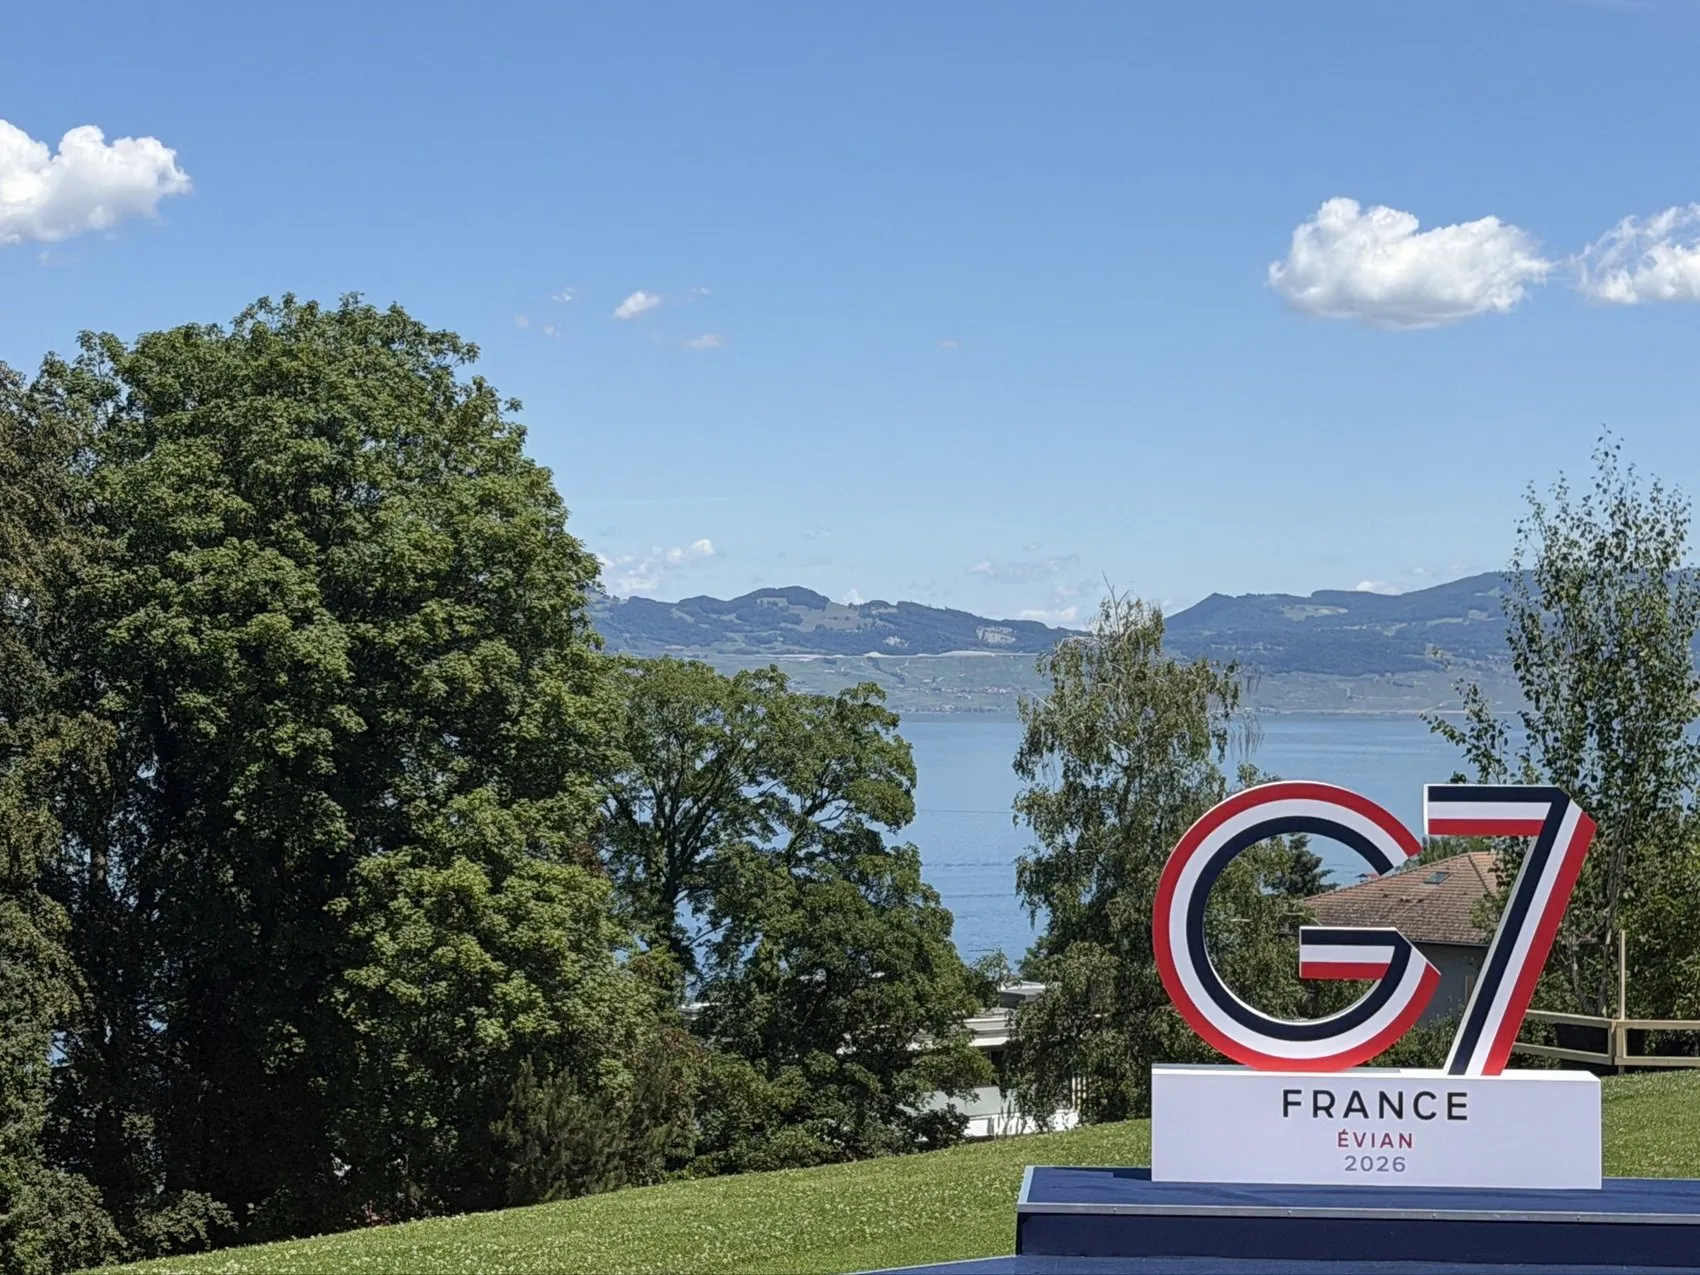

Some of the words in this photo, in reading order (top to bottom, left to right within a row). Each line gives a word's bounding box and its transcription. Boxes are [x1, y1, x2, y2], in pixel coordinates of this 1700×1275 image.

[1152, 780, 1598, 1075] G7
[1282, 1087, 1469, 1122] FRANCE
[1337, 1128, 1413, 1150] ÉVIAN
[1344, 1154, 1406, 1173] 2026
